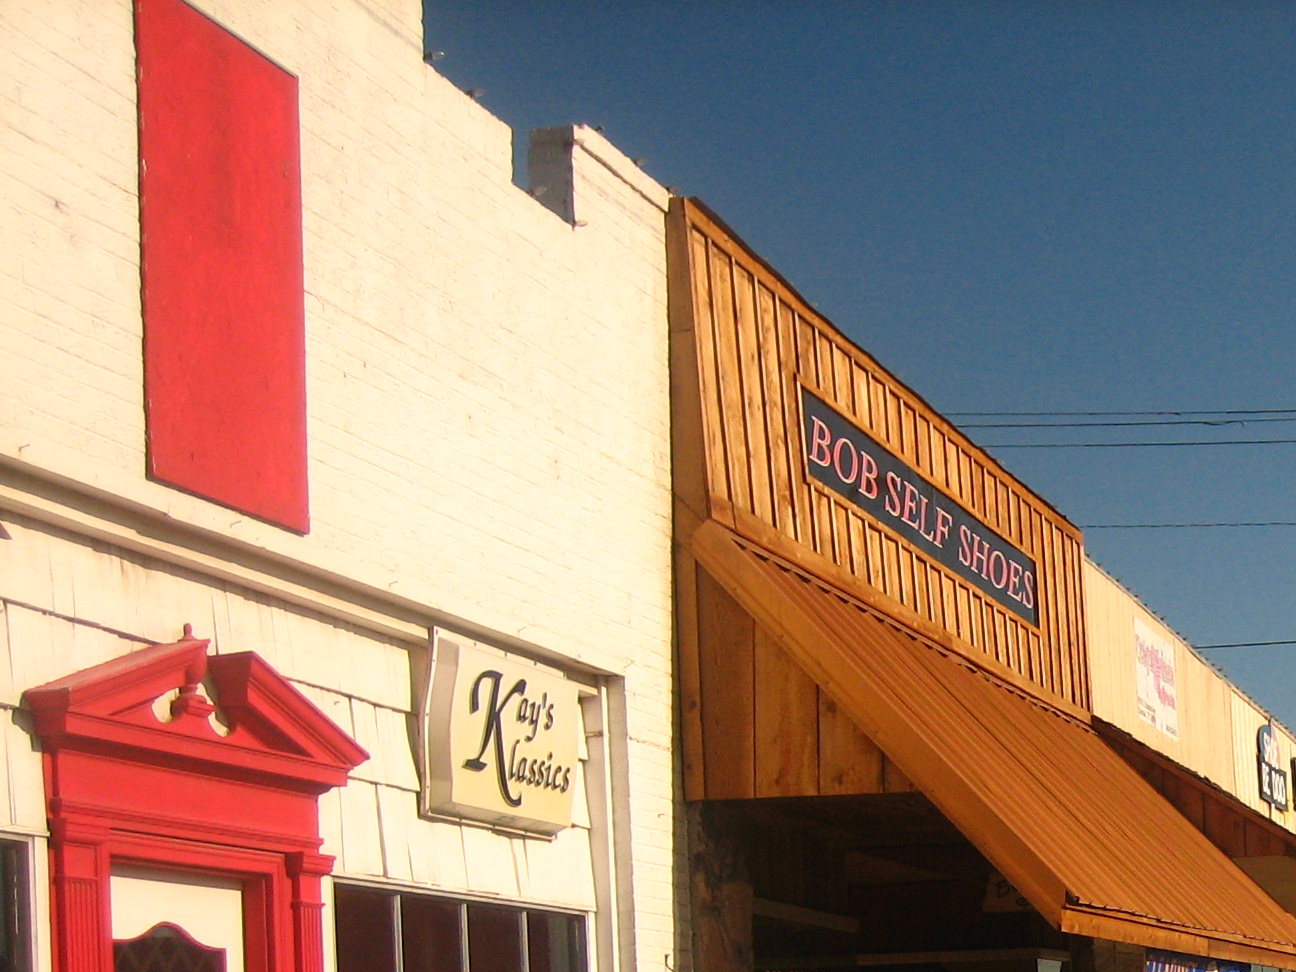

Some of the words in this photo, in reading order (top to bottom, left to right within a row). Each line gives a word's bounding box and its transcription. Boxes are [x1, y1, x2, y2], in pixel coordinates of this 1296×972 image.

[808, 415, 879, 499] BOB
[885, 470, 953, 548] SELF
[958, 524, 1034, 609] SHOES
